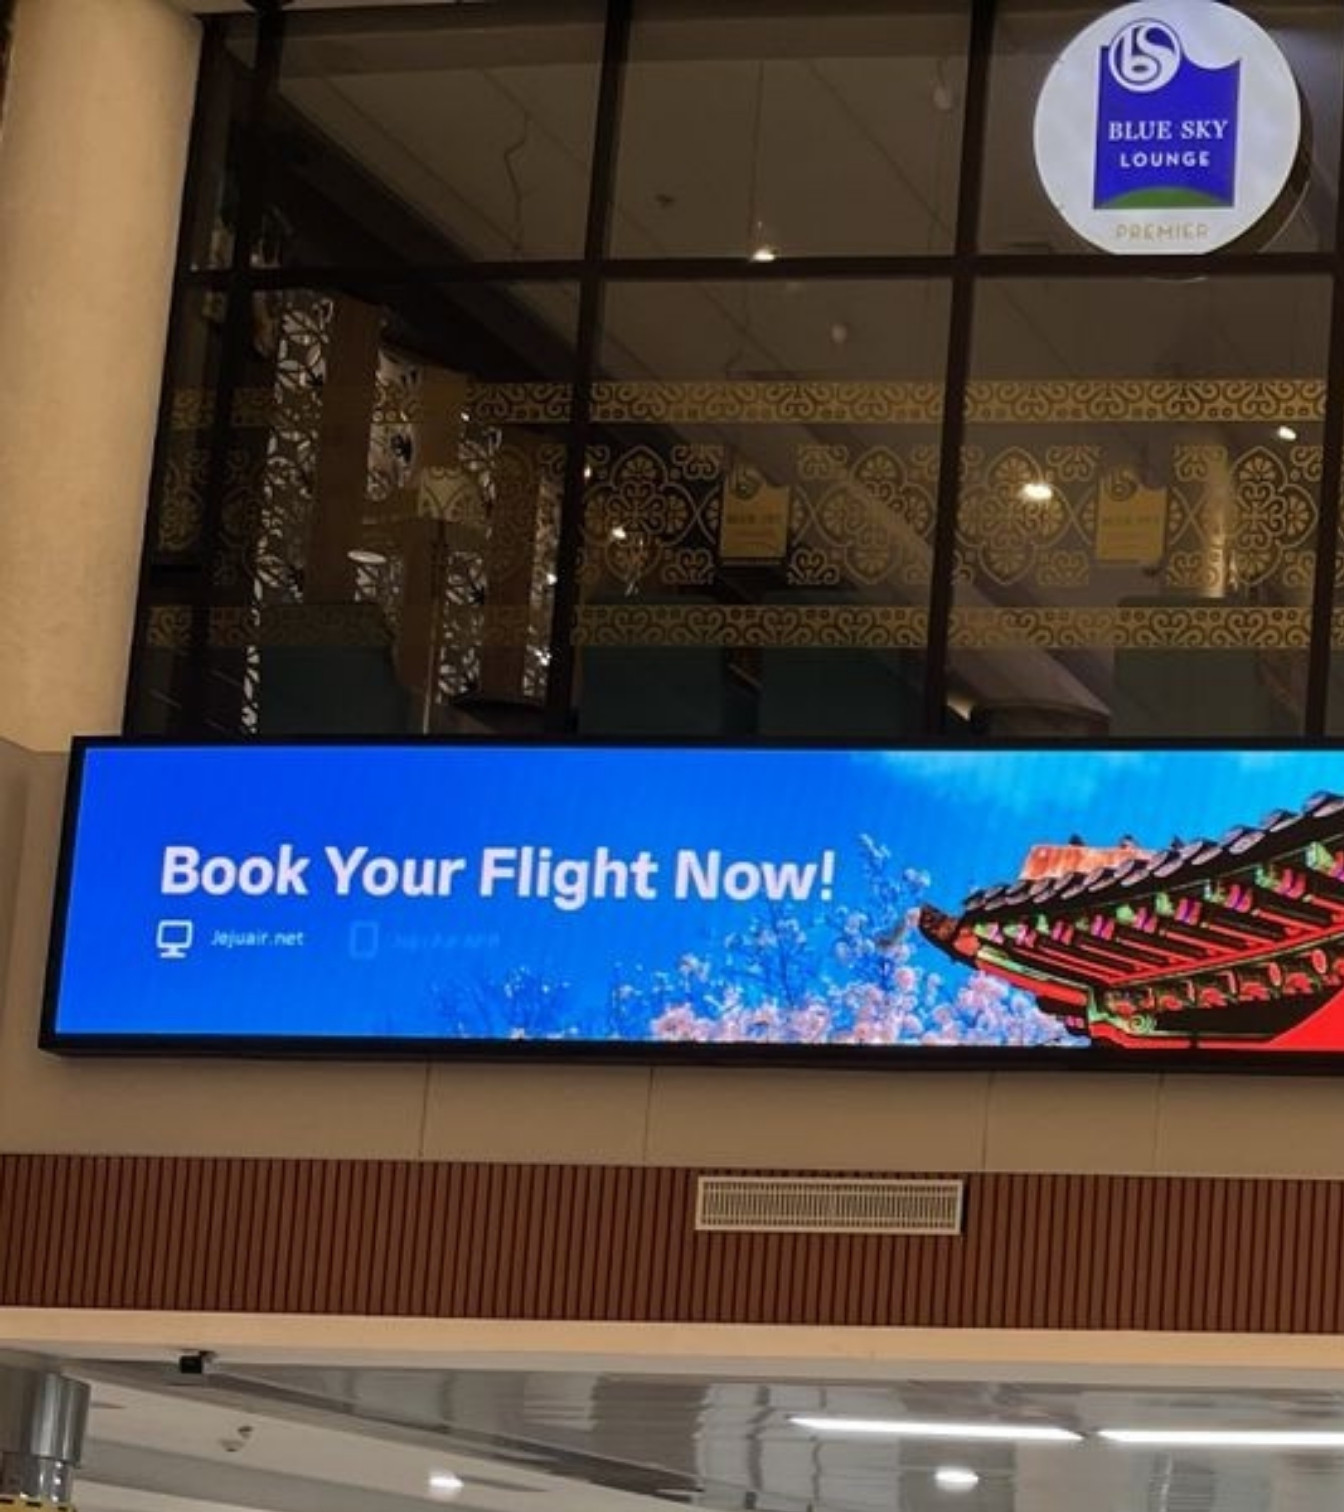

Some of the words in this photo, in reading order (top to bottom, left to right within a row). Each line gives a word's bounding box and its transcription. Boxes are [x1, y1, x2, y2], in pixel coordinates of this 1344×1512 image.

[1108, 120, 1172, 141] BLUE
[1181, 119, 1228, 140] SKY
[1120, 151, 1210, 167] LOUNGE
[1116, 223, 1208, 240] PREMIER
[161, 843, 310, 896] Book
[325, 845, 467, 897] Your
[479, 846, 658, 911] Flight
[675, 849, 835, 901] Now!
[211, 930, 303, 948] Jejuair.net
